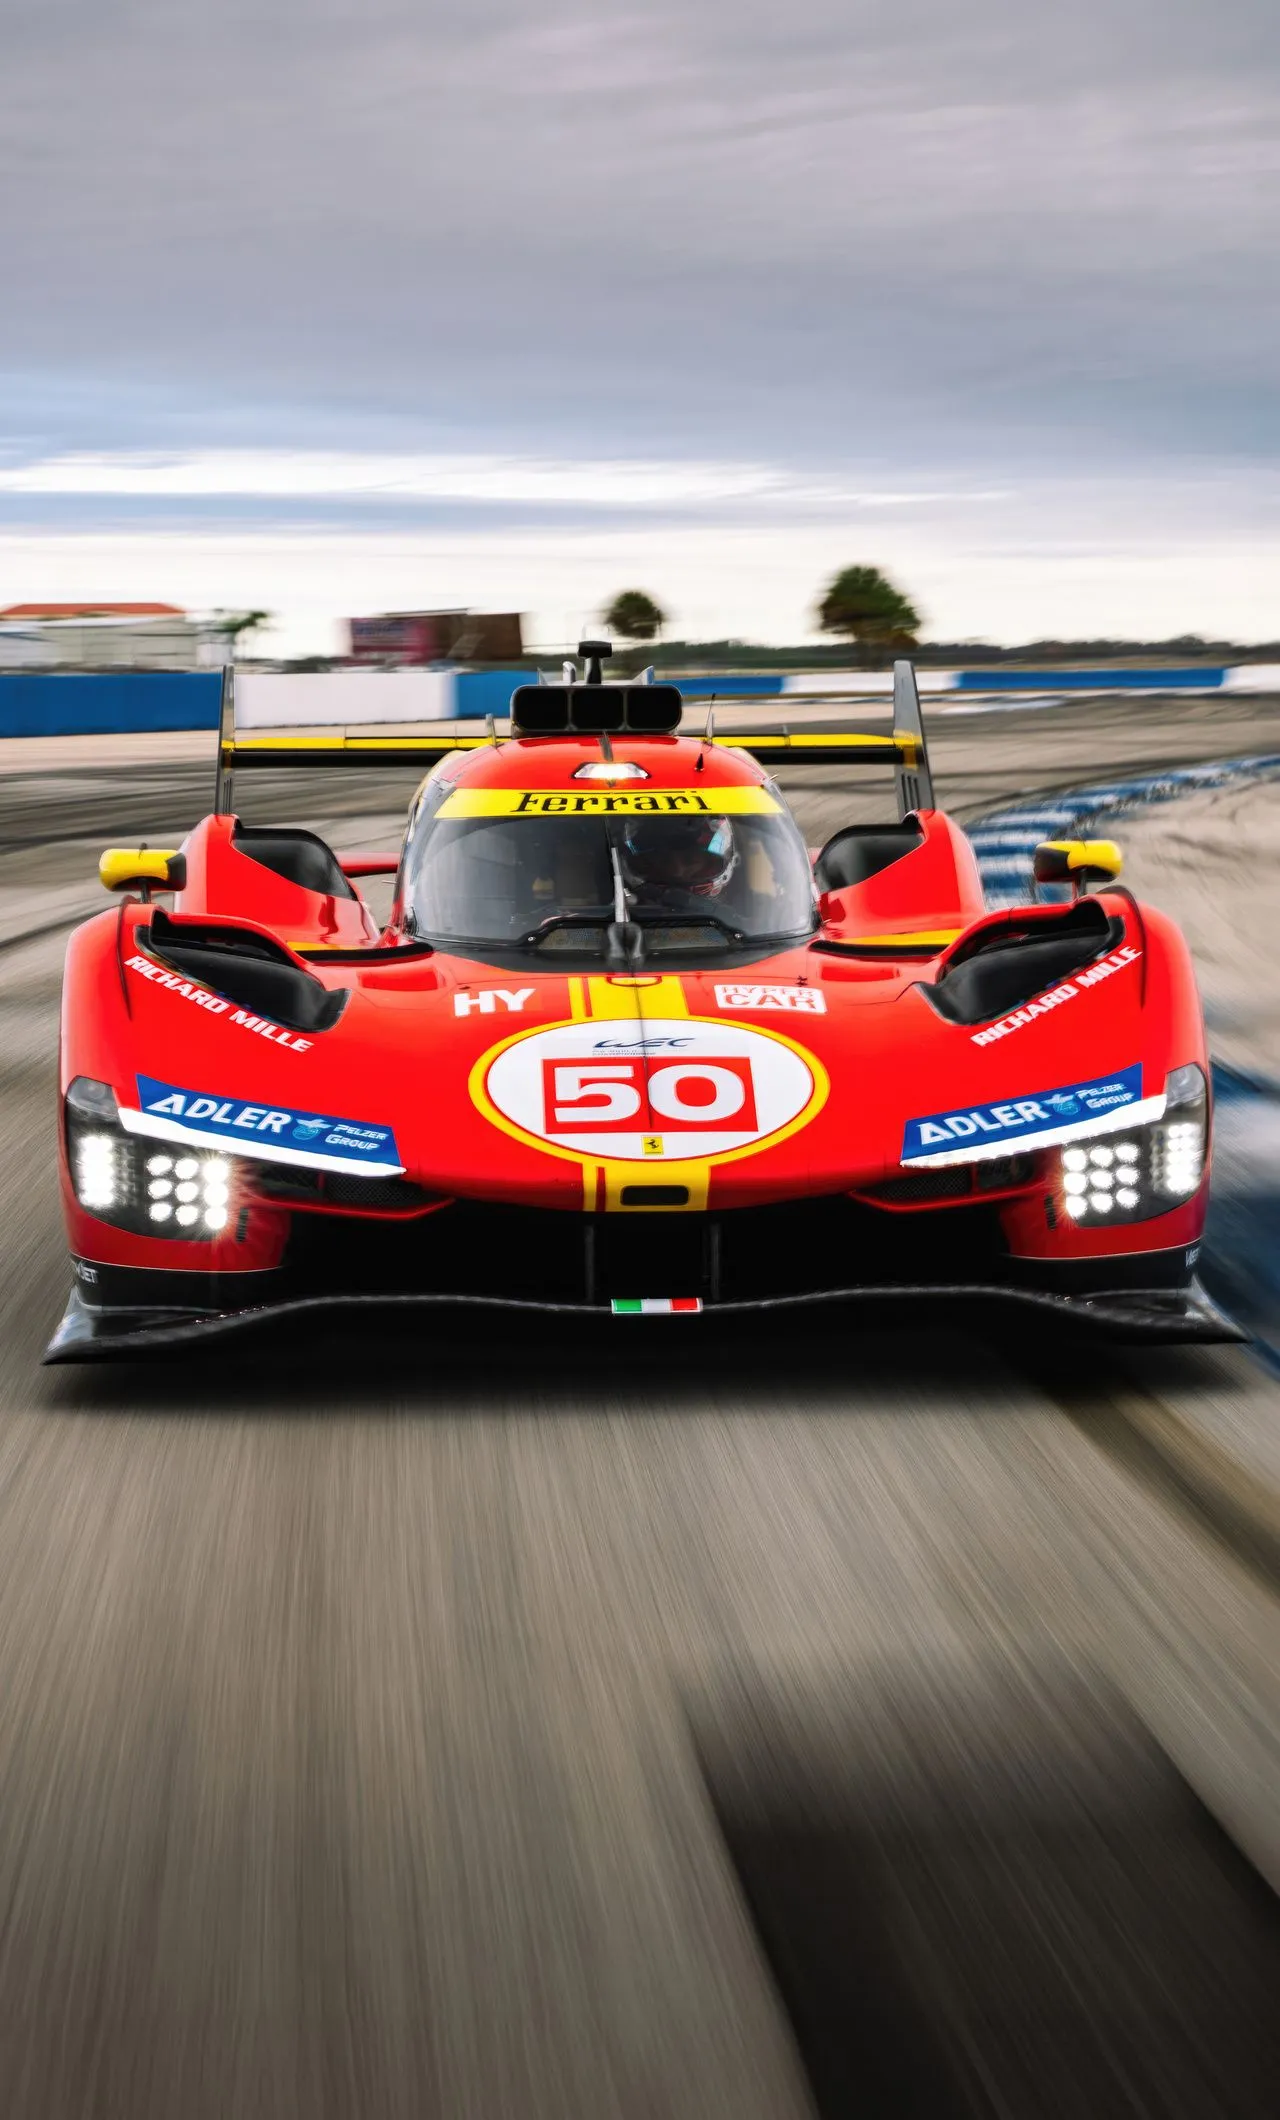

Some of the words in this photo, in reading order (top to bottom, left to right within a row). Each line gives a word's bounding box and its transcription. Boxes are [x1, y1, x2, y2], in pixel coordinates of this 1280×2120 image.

[510, 790, 711, 812] Ferrari
[124, 955, 230, 1014] RICHARD
[229, 1009, 315, 1053] MILLE
[454, 988, 536, 1016] HY
[725, 994, 816, 1009] CAR
[970, 983, 1080, 1047] RICHARD
[1075, 945, 1143, 988] MILLE
[594, 1037, 696, 1048] WEC
[554, 1064, 745, 1123] 50
[146, 1093, 293, 1133] ADLER
[916, 1100, 1051, 1145] ADLER
[325, 1133, 381, 1151] GROUP
[333, 1123, 390, 1141] PELZER
